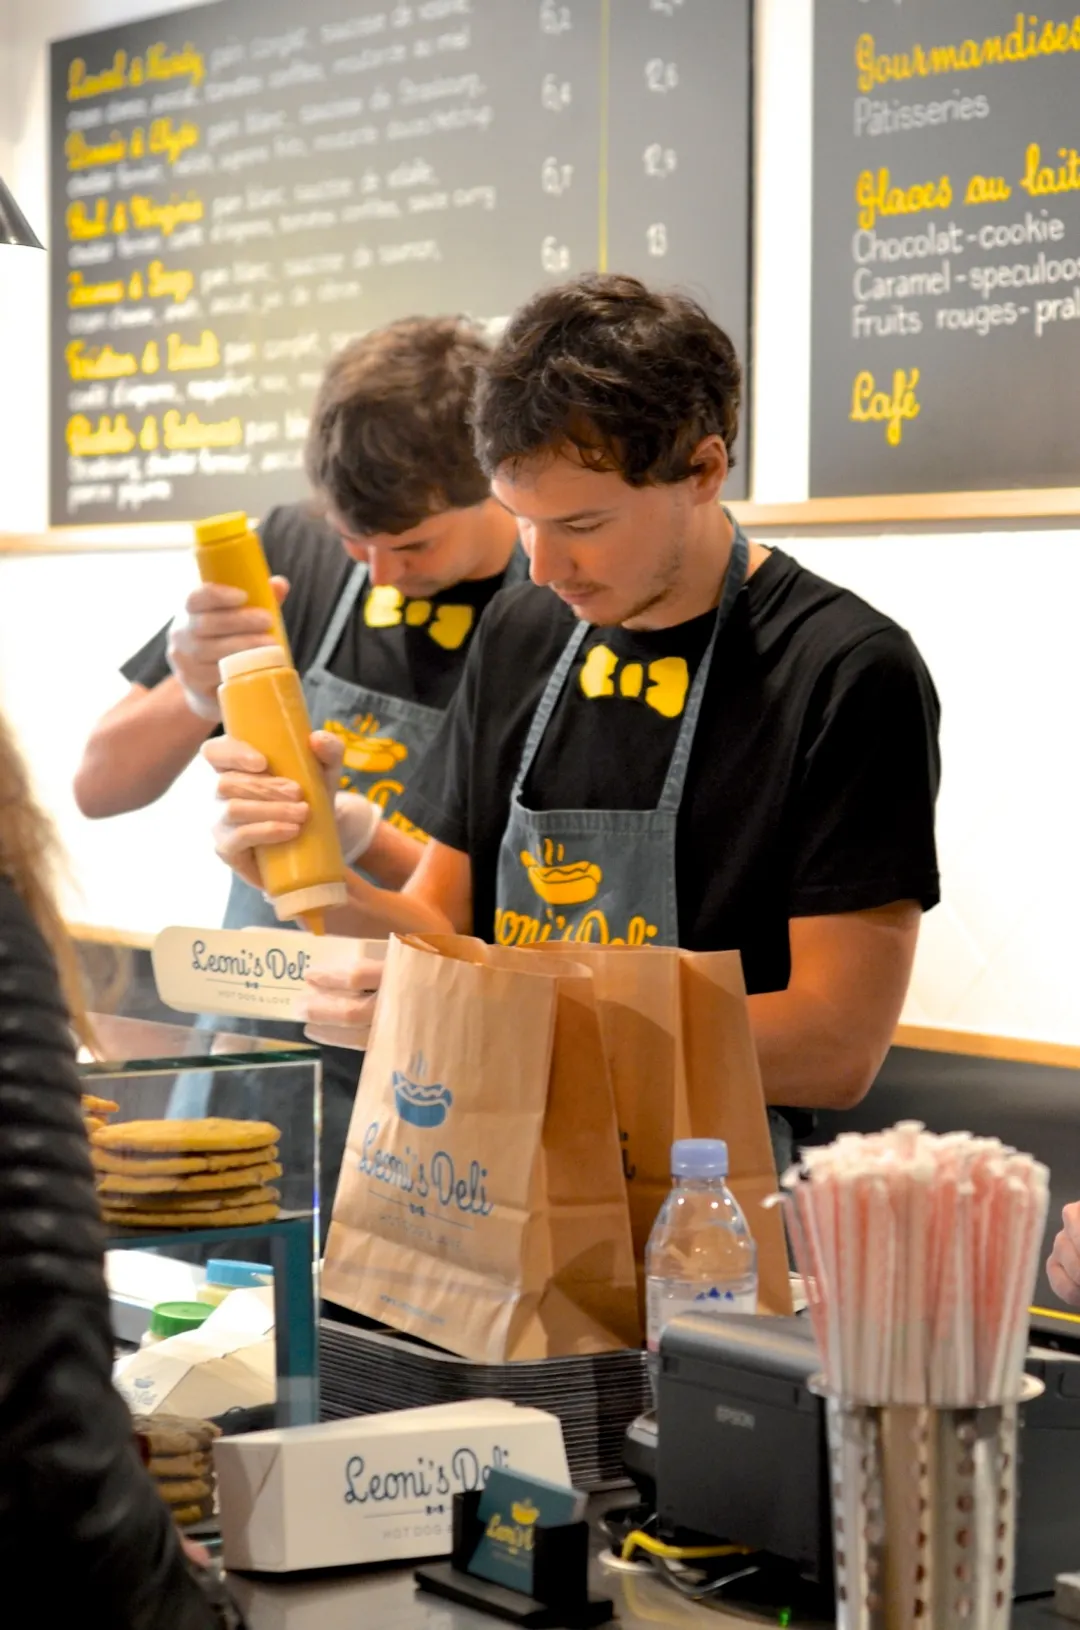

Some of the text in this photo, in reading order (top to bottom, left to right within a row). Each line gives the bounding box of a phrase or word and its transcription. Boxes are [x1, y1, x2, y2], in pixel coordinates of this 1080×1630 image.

[856, 142, 1080, 231] Glaces au lait
[849, 367, 921, 447] Café
[192, 940, 264, 978] Leoni's
[431, 1150, 495, 1217] Deli
[715, 1403, 755, 1430] EPSON
[344, 1455, 450, 1504] Leoni's
